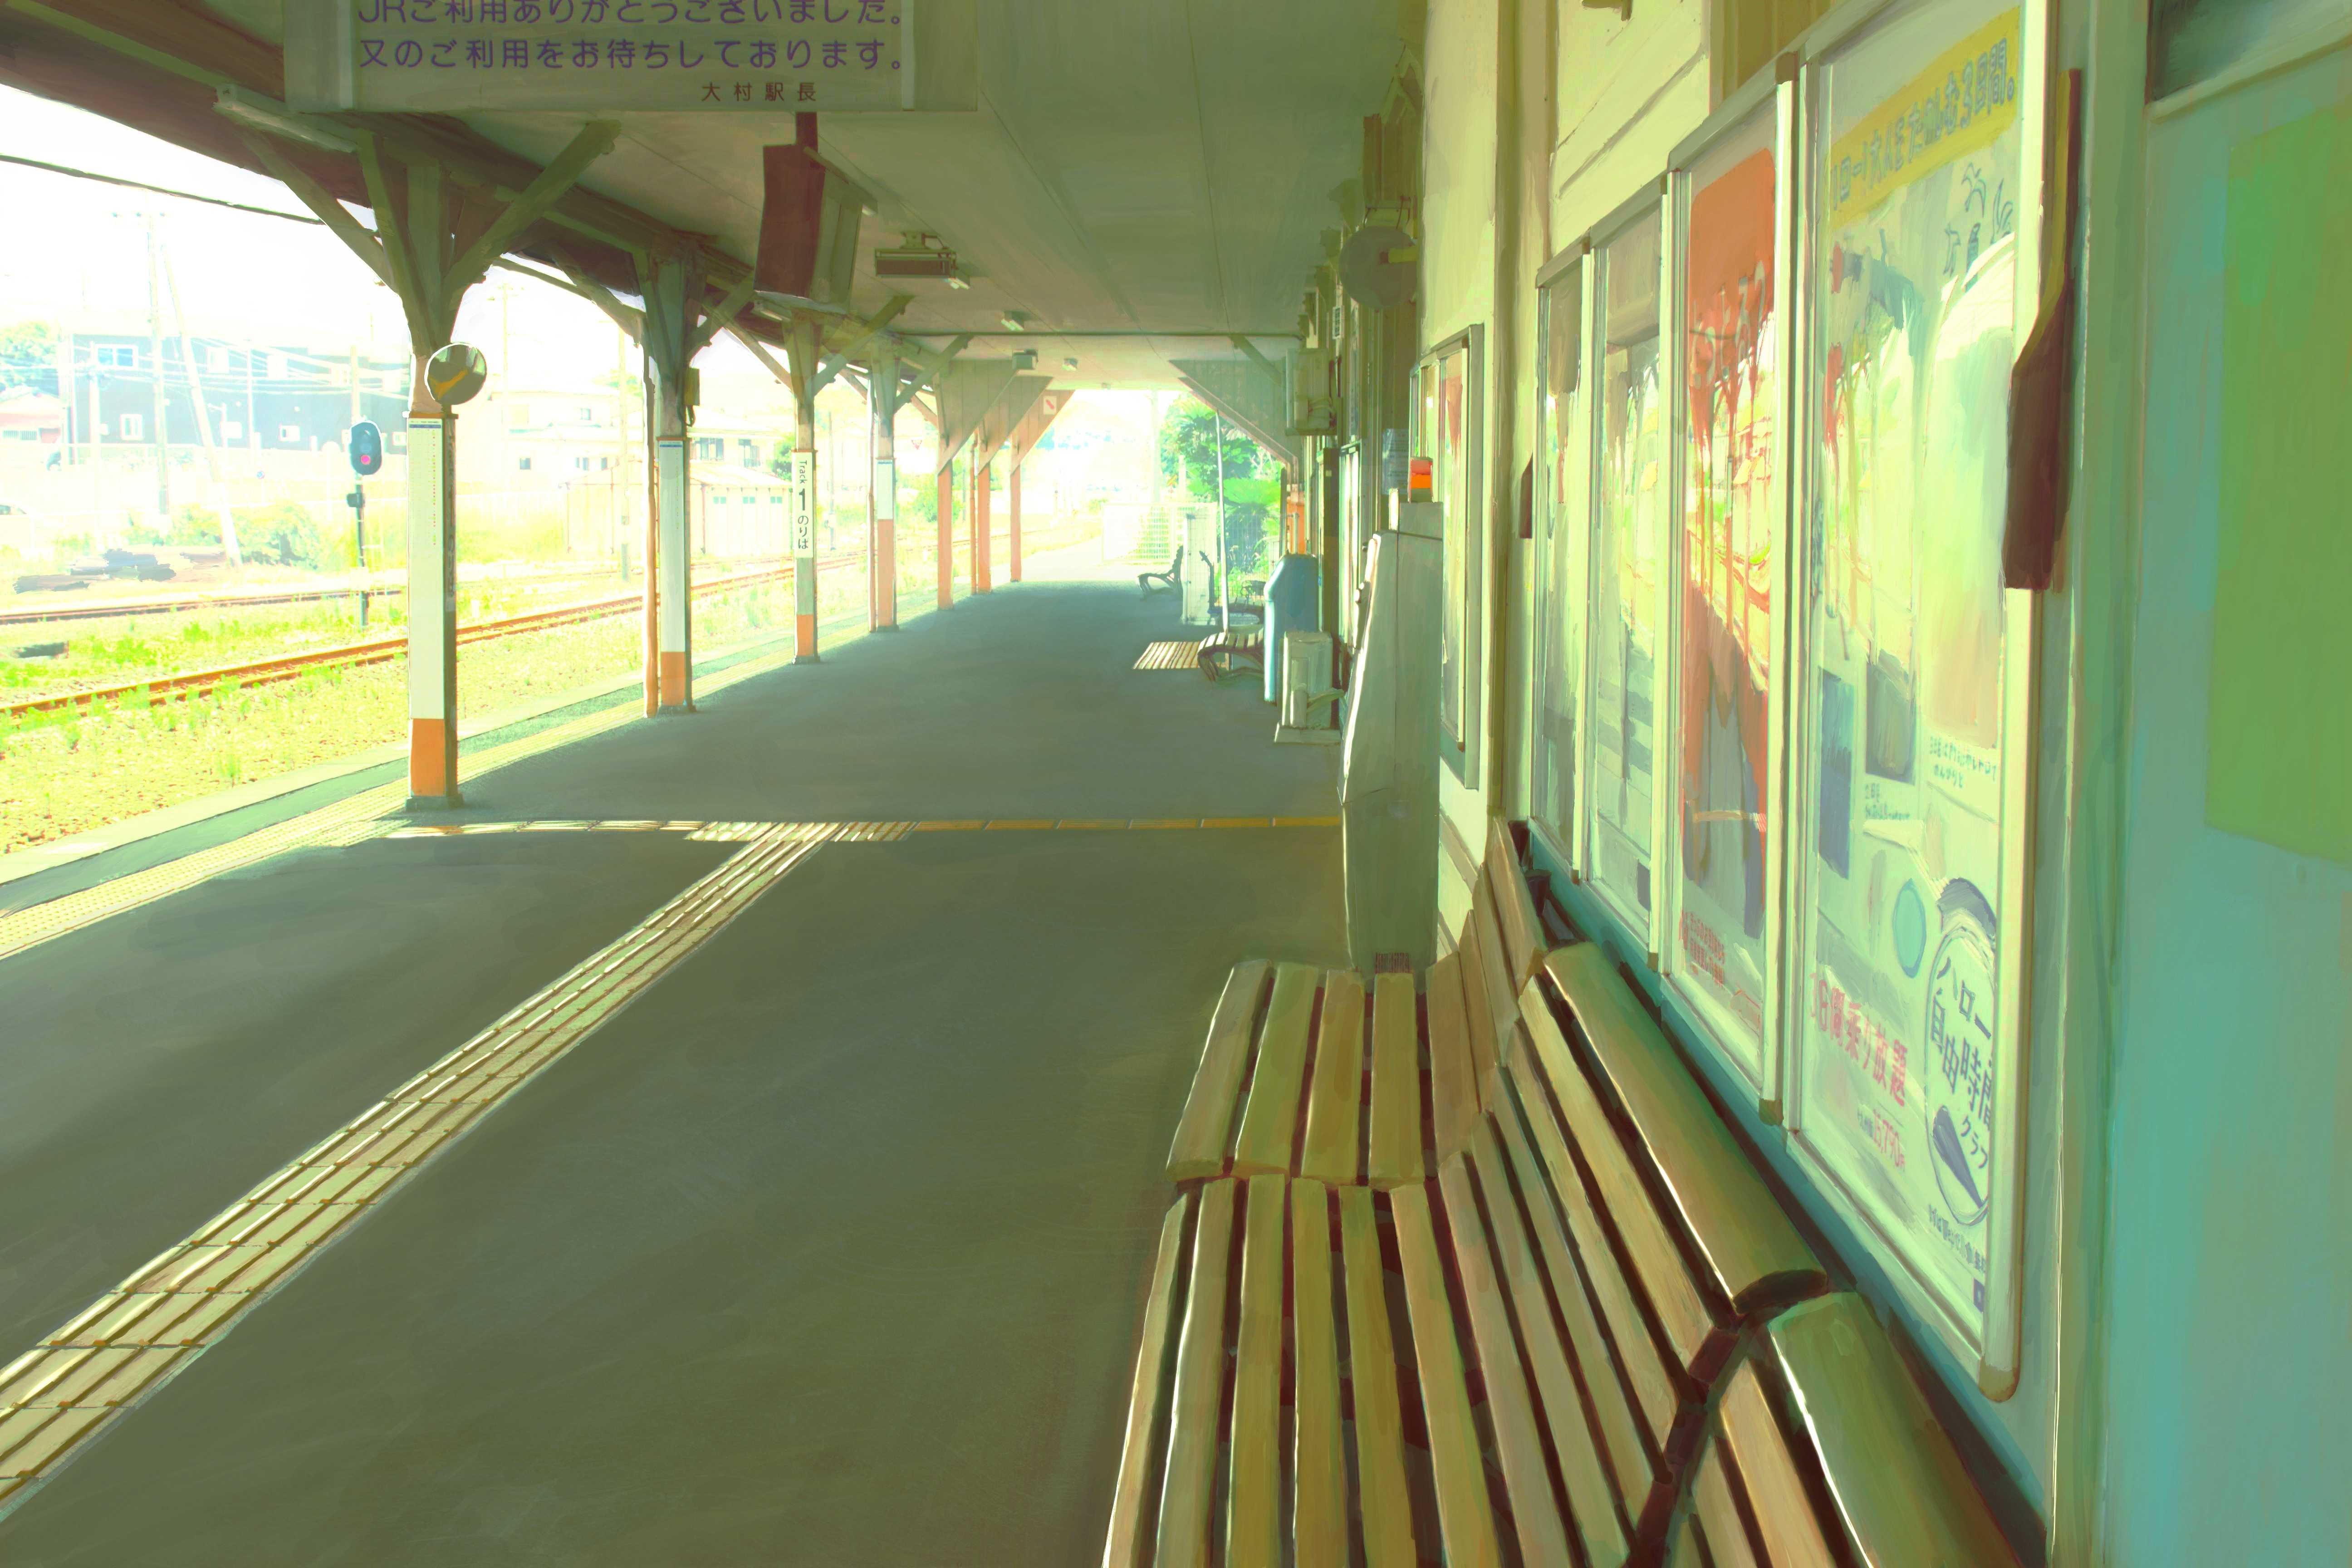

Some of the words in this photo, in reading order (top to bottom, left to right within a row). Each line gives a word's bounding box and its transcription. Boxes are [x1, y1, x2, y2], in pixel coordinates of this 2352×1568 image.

[360, 39, 900, 69] 又のご利用をお待ちしております。
[701, 82, 816, 102] 大村駅長
[799, 460, 808, 484] Track
